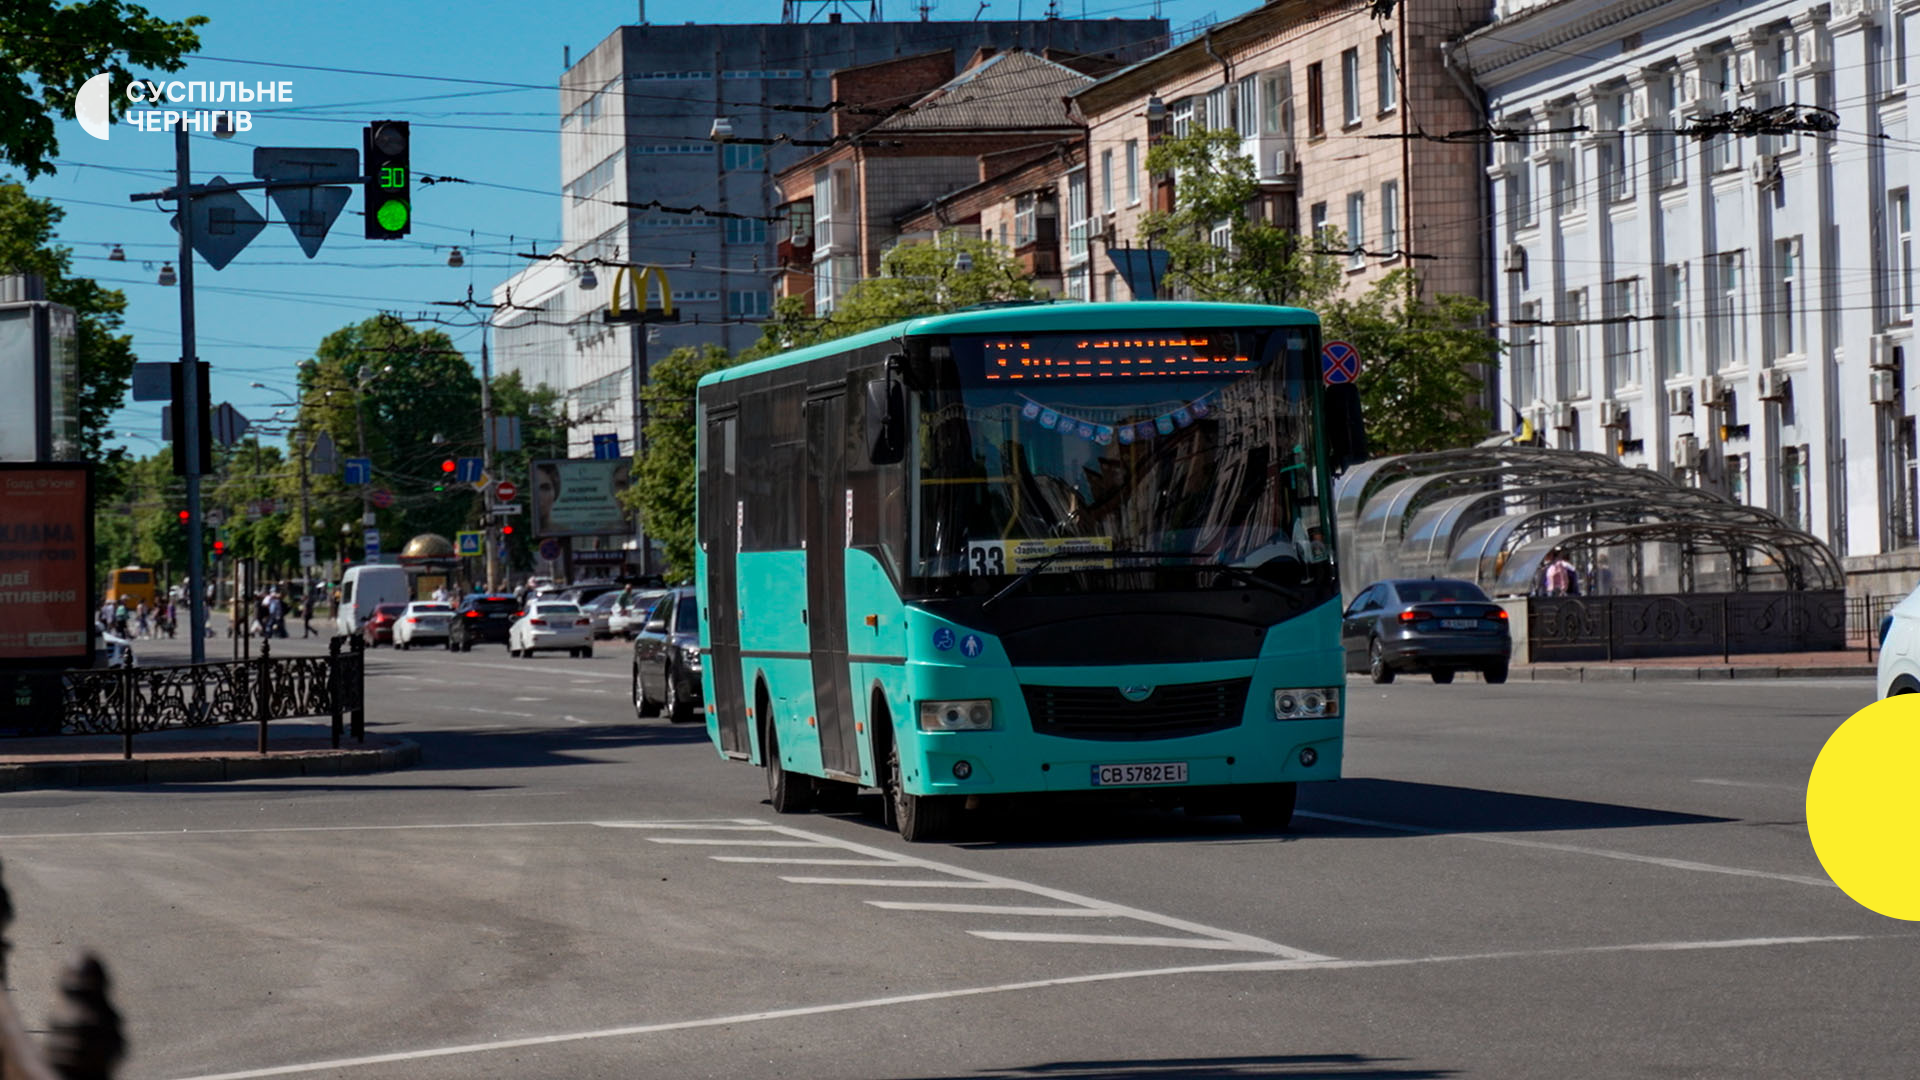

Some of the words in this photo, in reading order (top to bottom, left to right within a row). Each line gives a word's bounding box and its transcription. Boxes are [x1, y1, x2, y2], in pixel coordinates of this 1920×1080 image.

[380, 167, 405, 188] 30
[970, 547, 1005, 576] 33
[1101, 767, 1123, 783] CB
[1126, 766, 1161, 781] 5782
[1164, 765, 1182, 780] EI
